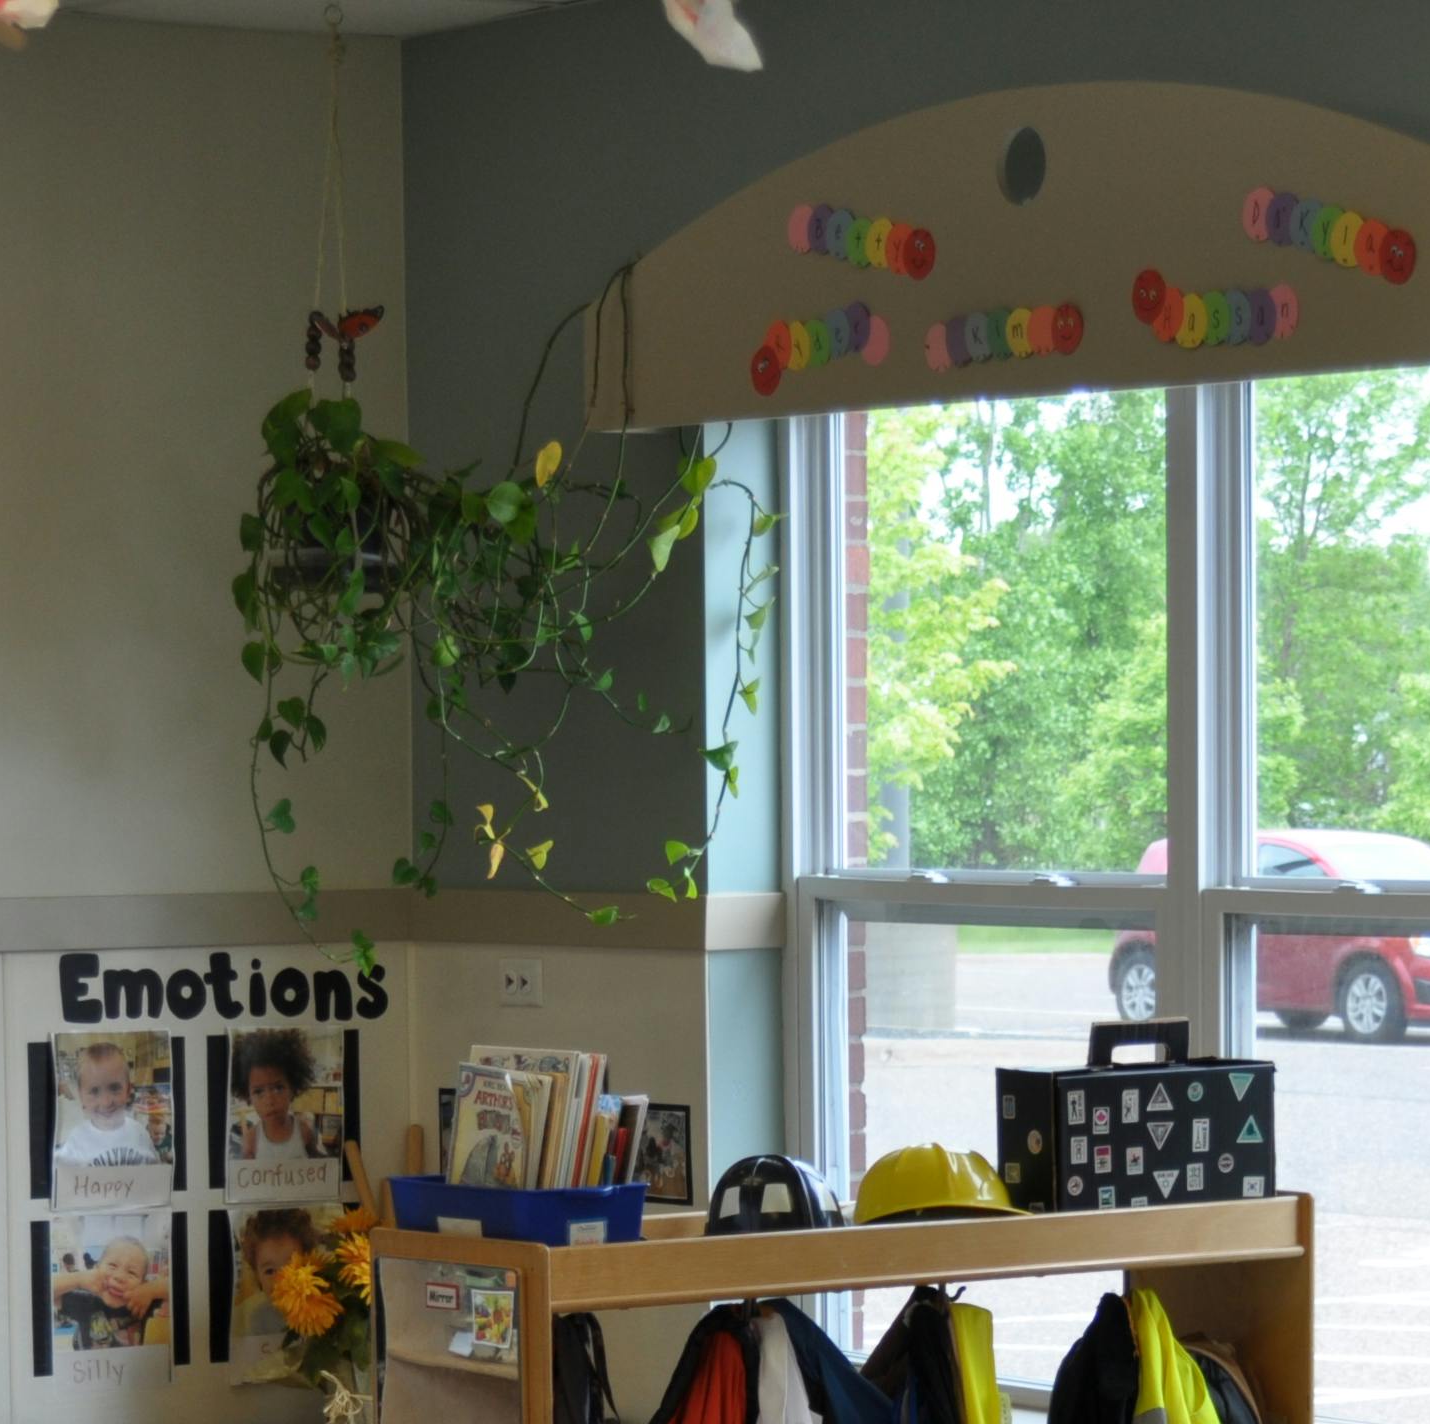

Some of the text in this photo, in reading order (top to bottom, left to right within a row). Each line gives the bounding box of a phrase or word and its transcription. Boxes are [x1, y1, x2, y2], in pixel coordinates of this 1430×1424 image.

[815, 219, 902, 262] Betty
[1162, 301, 1289, 329] Hassan
[775, 322, 860, 357] Ryder
[971, 319, 1024, 346] Kim
[59, 951, 388, 1024] Emotions
[74, 1175, 135, 1200] Happy
[236, 1162, 327, 1189] Confused
[429, 1289, 455, 1304] Mirror
[73, 1359, 125, 1387] Silly
